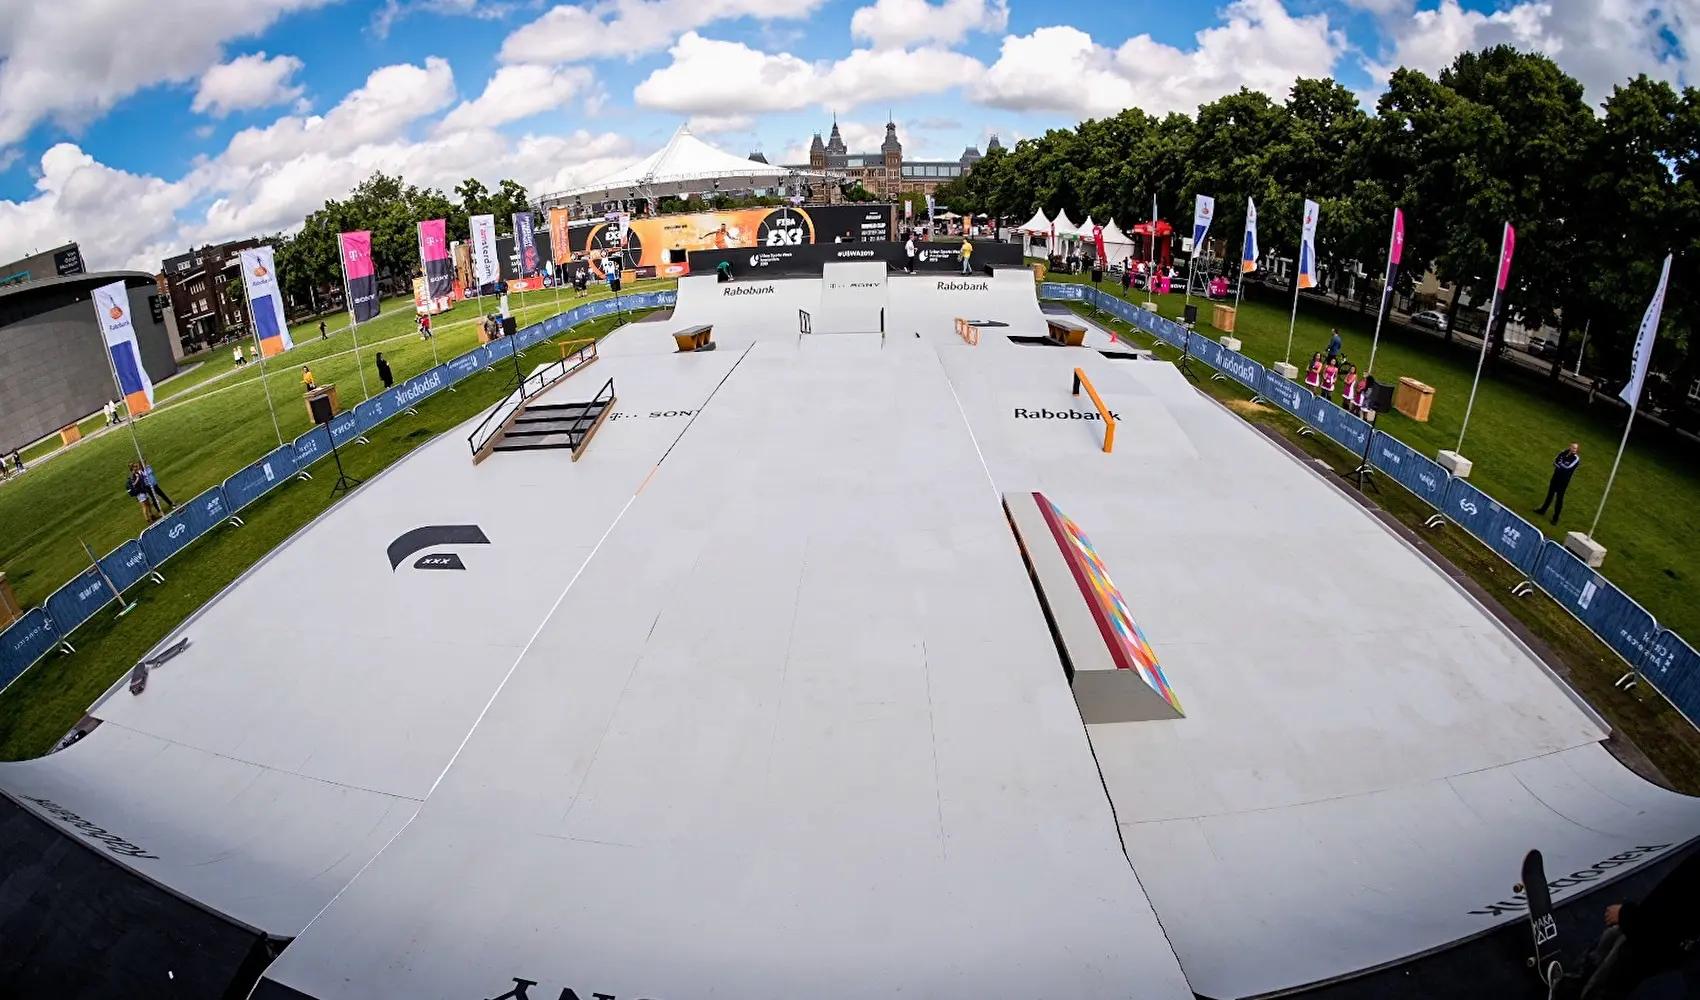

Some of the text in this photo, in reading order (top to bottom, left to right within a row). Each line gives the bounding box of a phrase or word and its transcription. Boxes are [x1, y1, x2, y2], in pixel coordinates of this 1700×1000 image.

[776, 218, 796, 227] FIBA
[723, 285, 775, 297] Rabobank
[937, 281, 989, 291] Rabobank
[354, 294, 375, 304] SONY
